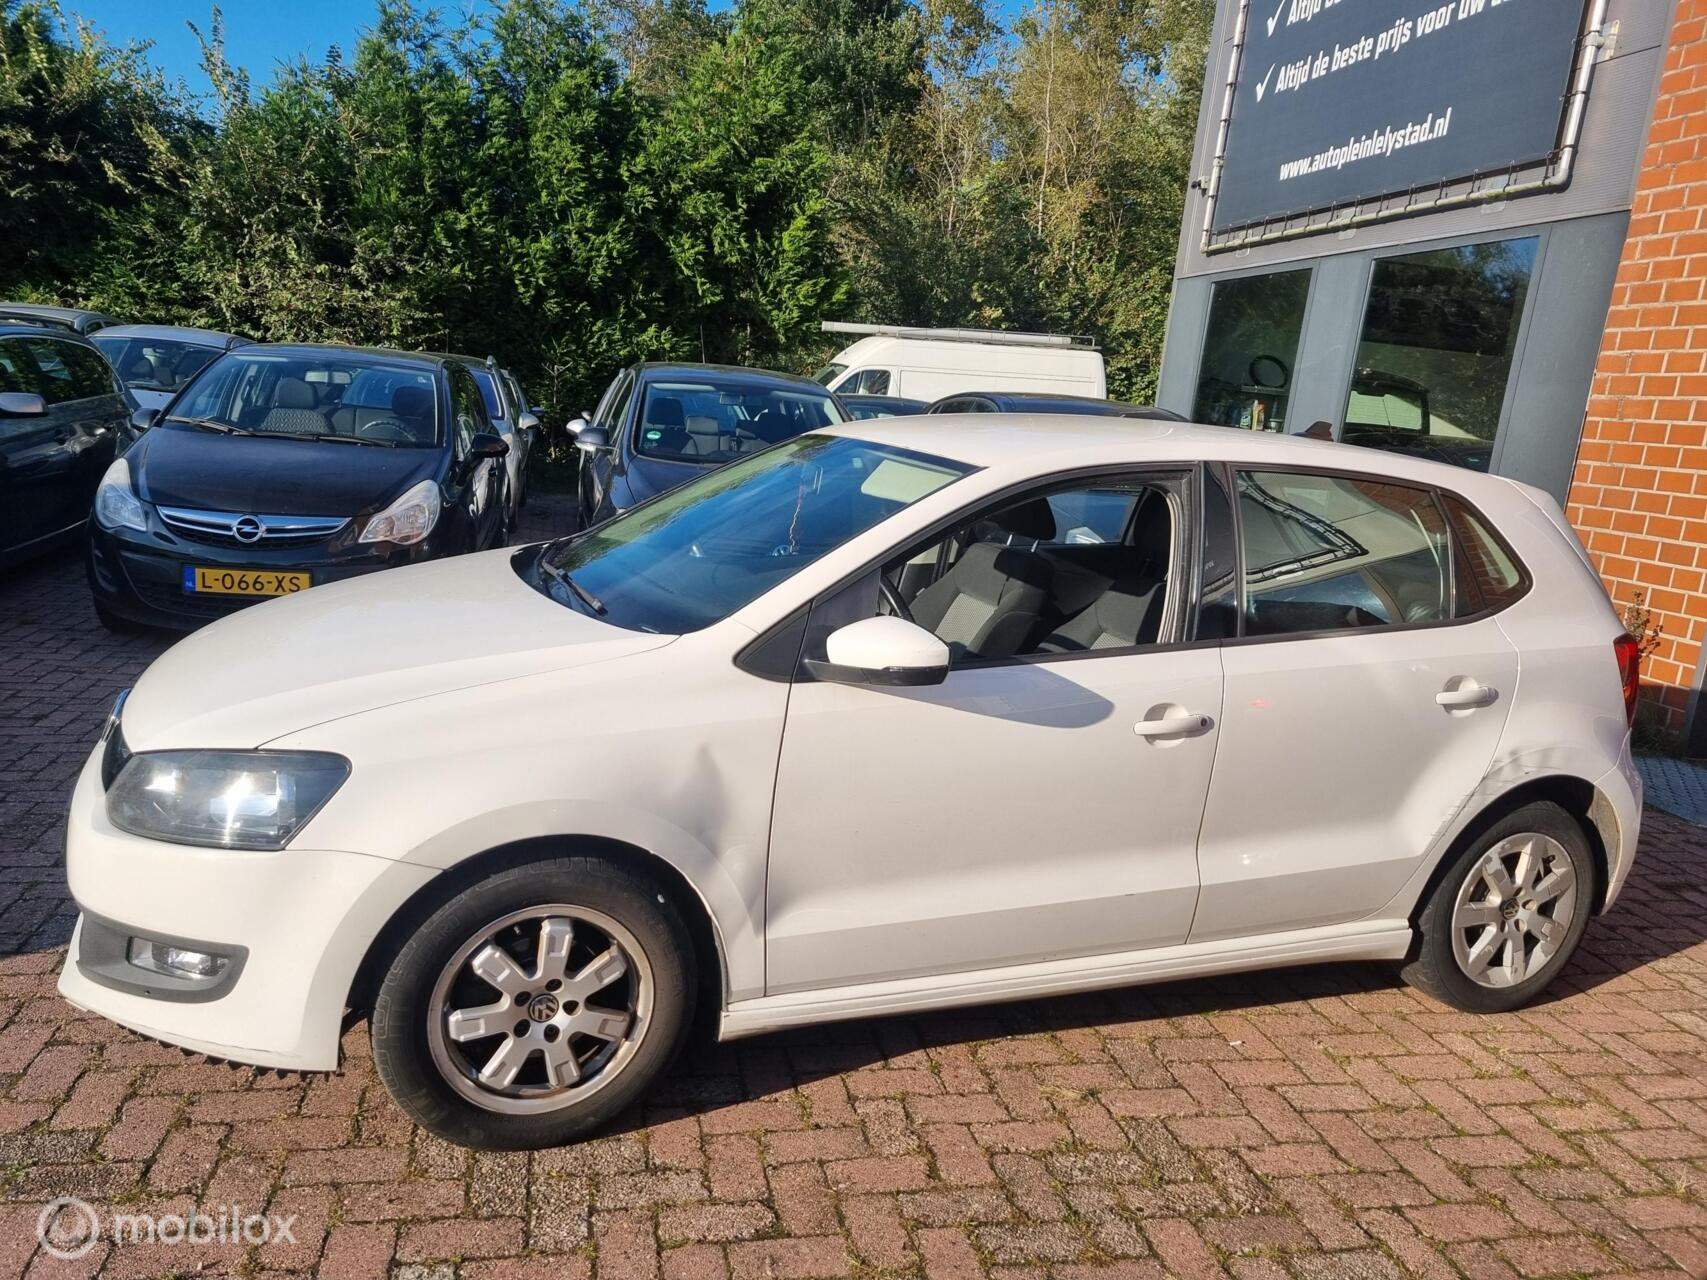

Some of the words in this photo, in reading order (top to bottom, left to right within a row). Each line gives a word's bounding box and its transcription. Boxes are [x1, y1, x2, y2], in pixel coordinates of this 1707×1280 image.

[1274, 55, 1312, 94] Altijd
[1311, 50, 1330, 80] de
[1331, 36, 1374, 72] beste
[1374, 17, 1413, 60] prijs
[1416, 2, 1456, 38] voor
[1279, 106, 1452, 181] www.autopleinlelystad.nl
[201, 572, 301, 592] L-066-XS
